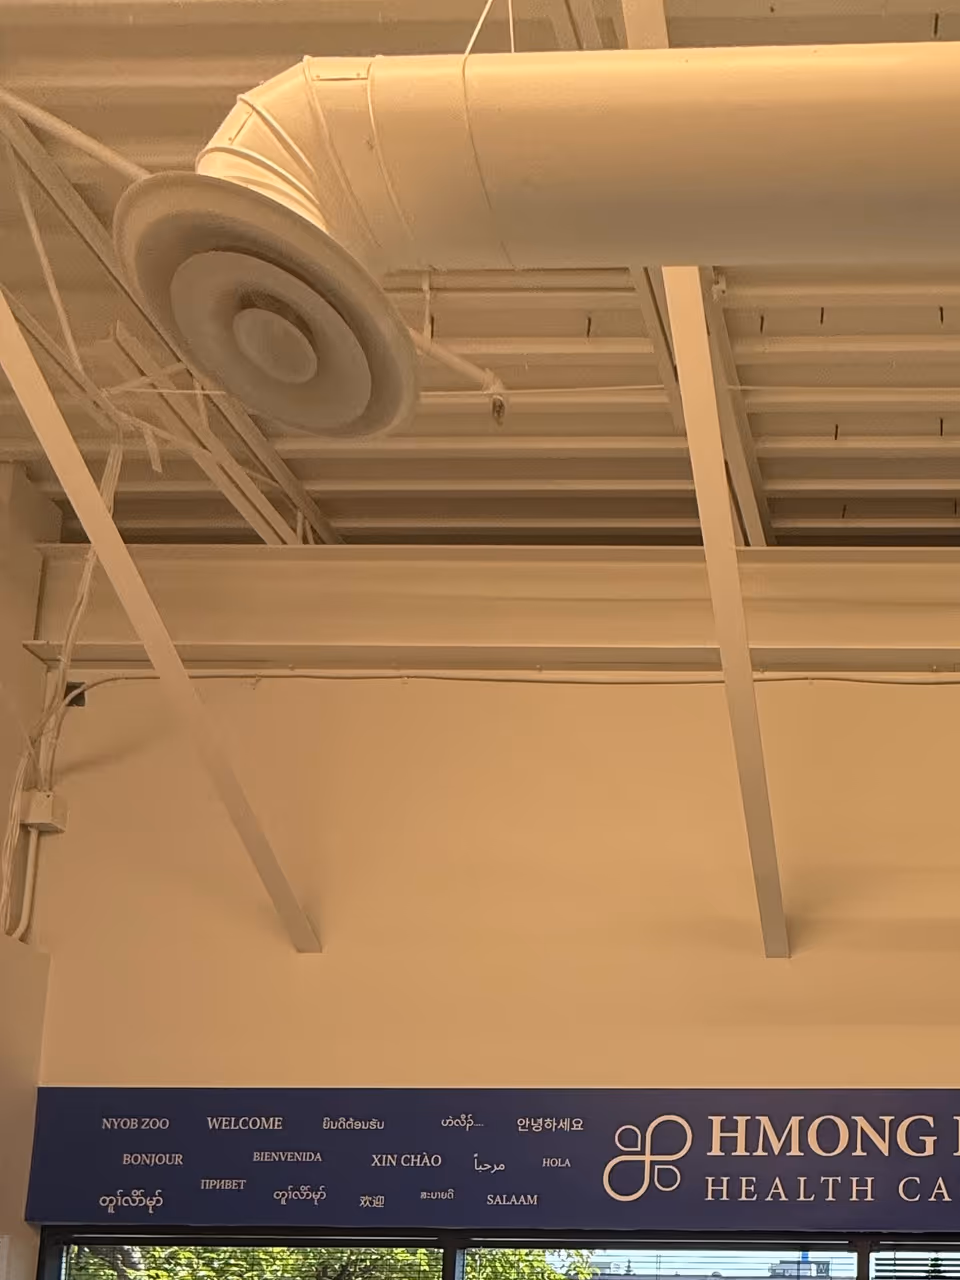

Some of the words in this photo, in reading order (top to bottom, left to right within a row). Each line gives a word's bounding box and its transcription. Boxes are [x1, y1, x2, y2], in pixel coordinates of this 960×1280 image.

[102, 1118, 138, 1129] NYOB
[141, 1118, 169, 1129] ZOO
[207, 1117, 282, 1129] WELCOME
[518, 1118, 583, 1131] 안녕하세요
[707, 1116, 937, 1156] HMONG
[123, 1154, 182, 1166] BONJOUR
[254, 1152, 321, 1161] BIENVENIDA
[372, 1155, 397, 1166] XIN
[401, 1152, 441, 1166] CHÀO
[543, 1158, 570, 1167] HOLA
[201, 1180, 246, 1189] ПРИВЕТ
[706, 1177, 874, 1200] HEALTH
[360, 1196, 384, 1207] 欢迎
[487, 1195, 537, 1204] SALAAM
